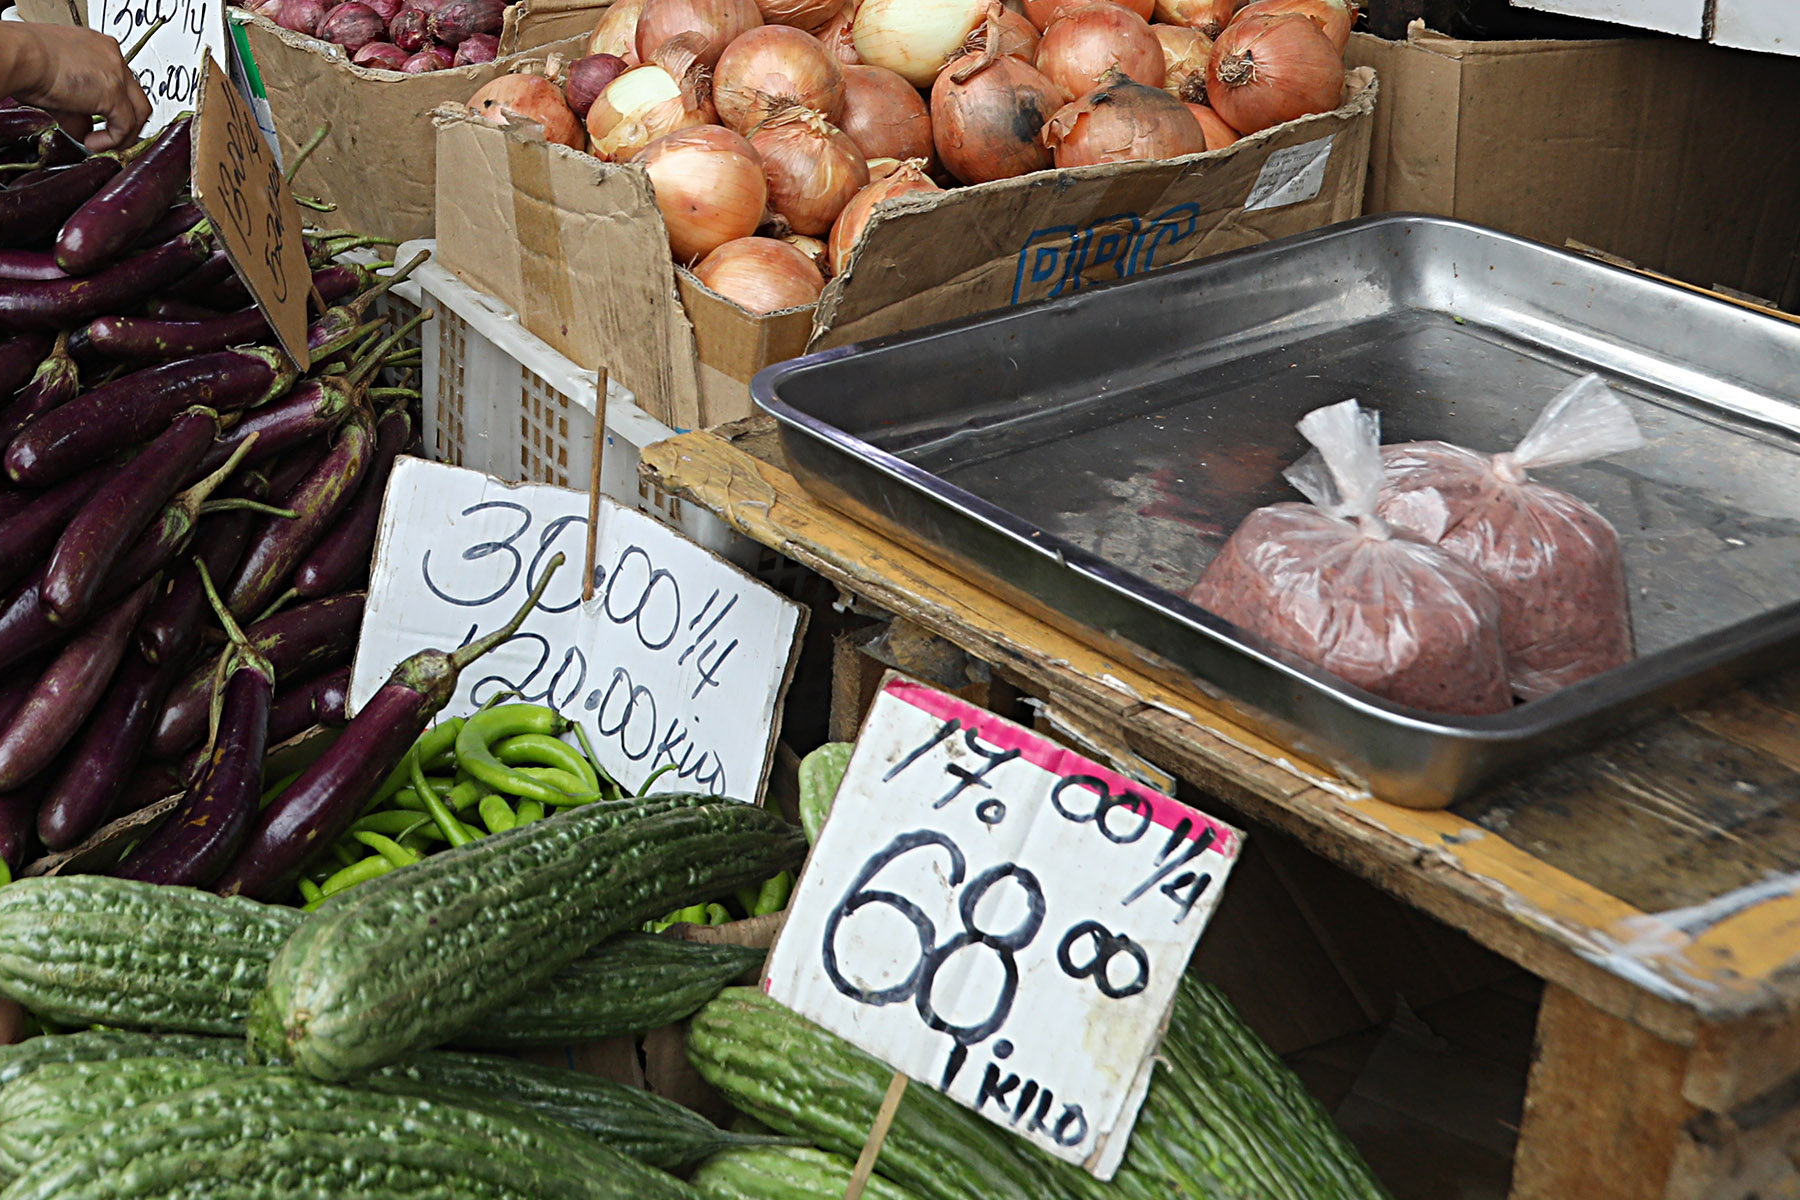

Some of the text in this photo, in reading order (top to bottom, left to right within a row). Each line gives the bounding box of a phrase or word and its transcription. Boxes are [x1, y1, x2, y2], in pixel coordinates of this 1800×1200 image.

[423, 501, 738, 700] 30.00 1/4
[1121, 817, 1213, 925] 1/4
